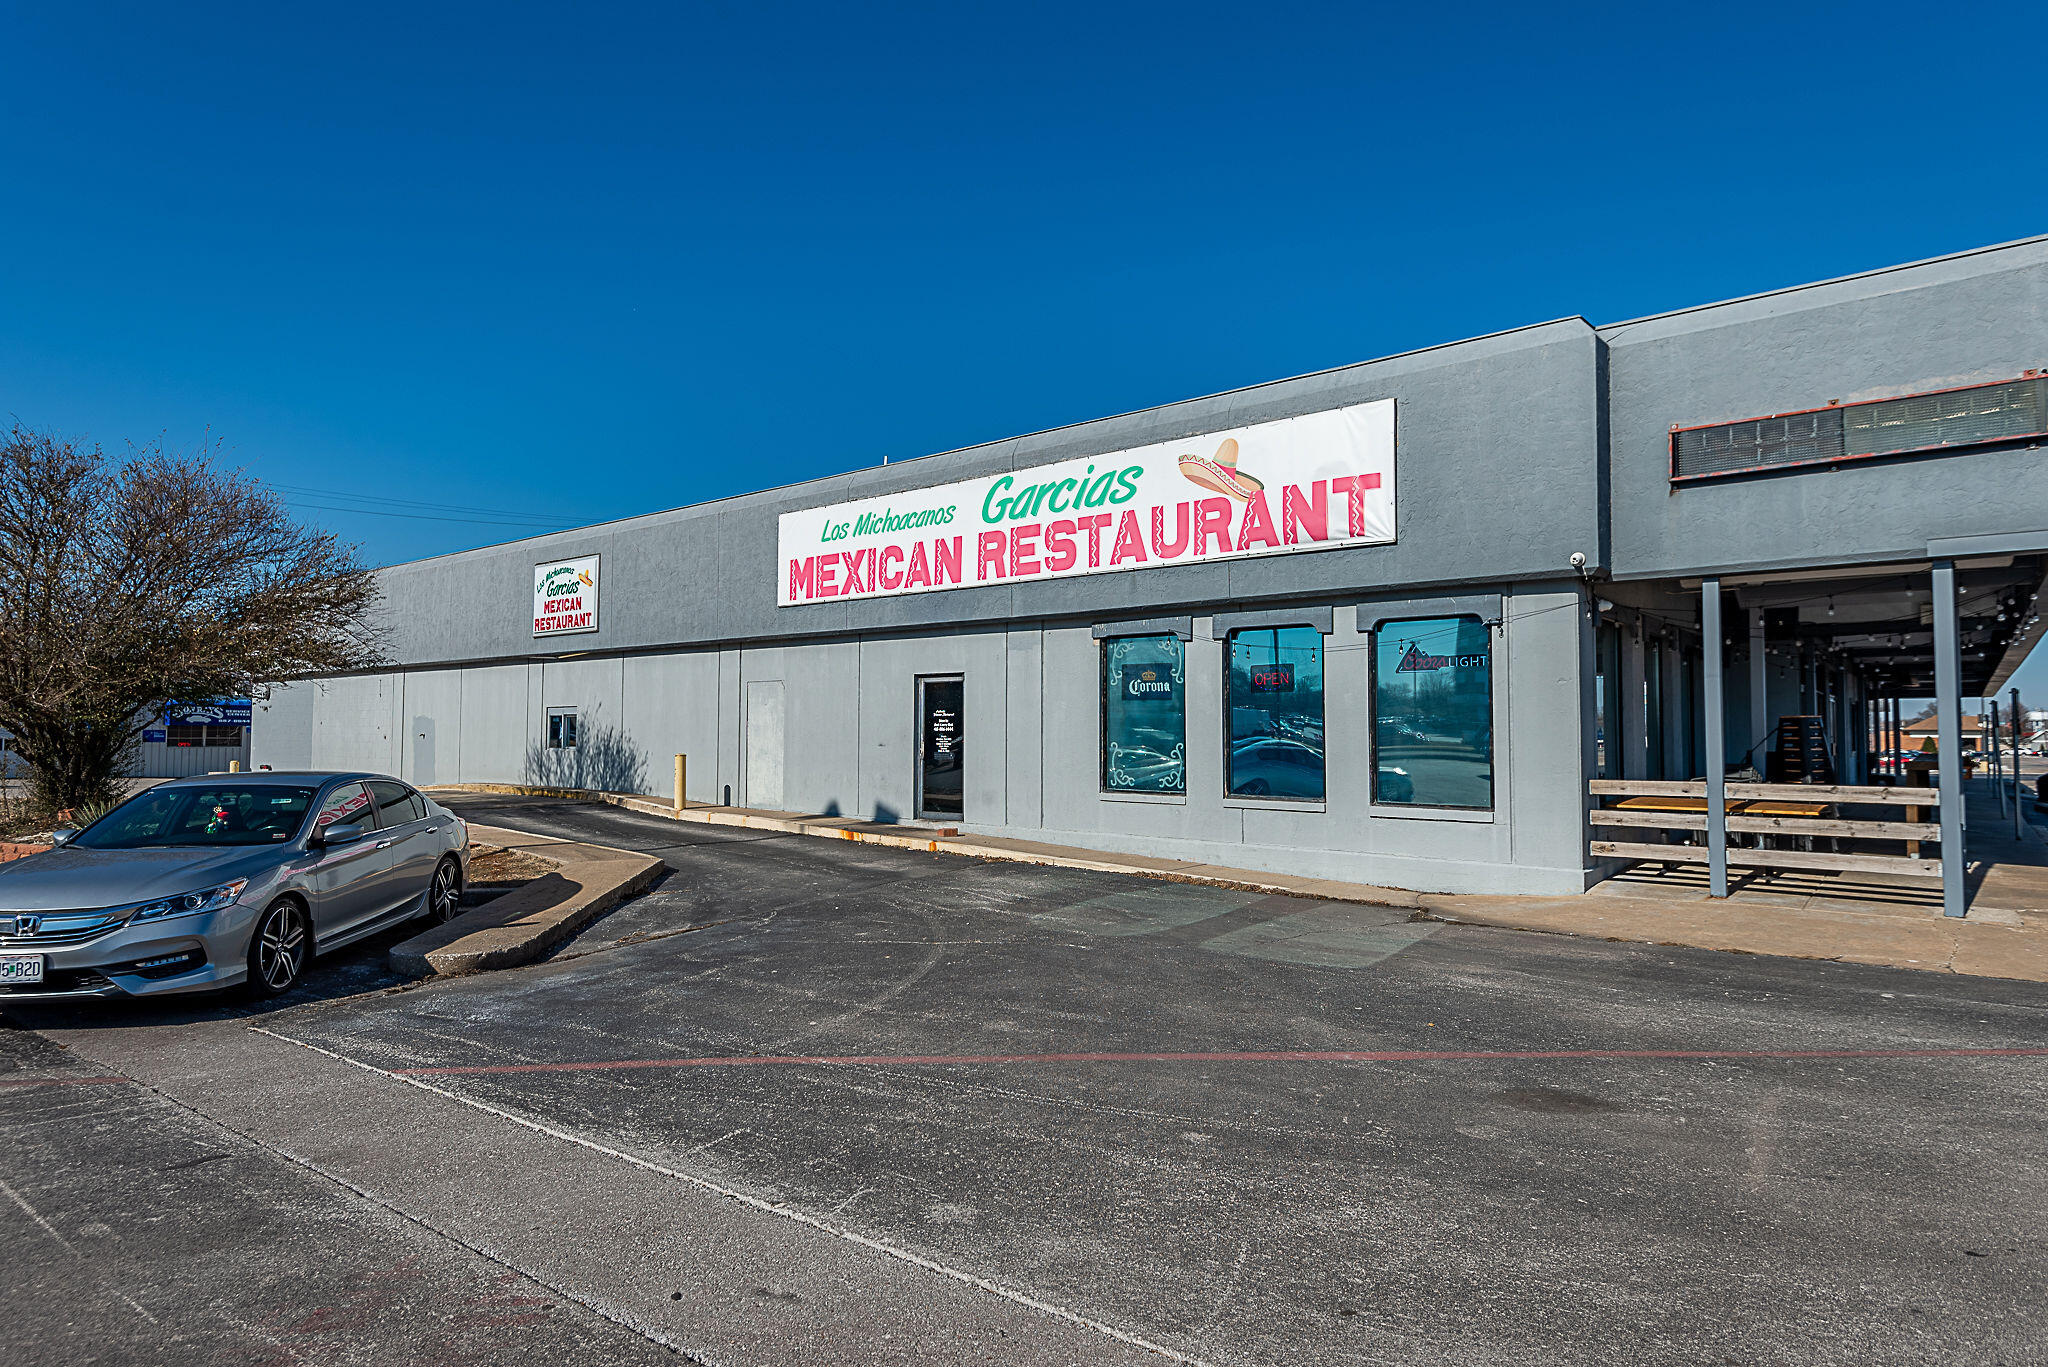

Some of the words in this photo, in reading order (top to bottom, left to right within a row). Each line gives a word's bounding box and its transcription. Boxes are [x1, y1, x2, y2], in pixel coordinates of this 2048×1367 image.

[981, 464, 1144, 524] Garcias
[820, 519, 850, 543] Los
[852, 504, 957, 538] Michoacanos
[789, 535, 963, 601] MEXICAN
[977, 472, 1382, 581] RESTAURANT
[546, 579, 580, 597] Garcias
[543, 596, 582, 614] MEXICAN
[534, 612, 592, 631] RESTAURANT
[1403, 652, 1448, 670] Coors
[1448, 655, 1487, 668] LIGHT
[1254, 671, 1290, 686] OPEN
[1128, 679, 1171, 697] Corona
[16, 961, 41, 977] B2D
